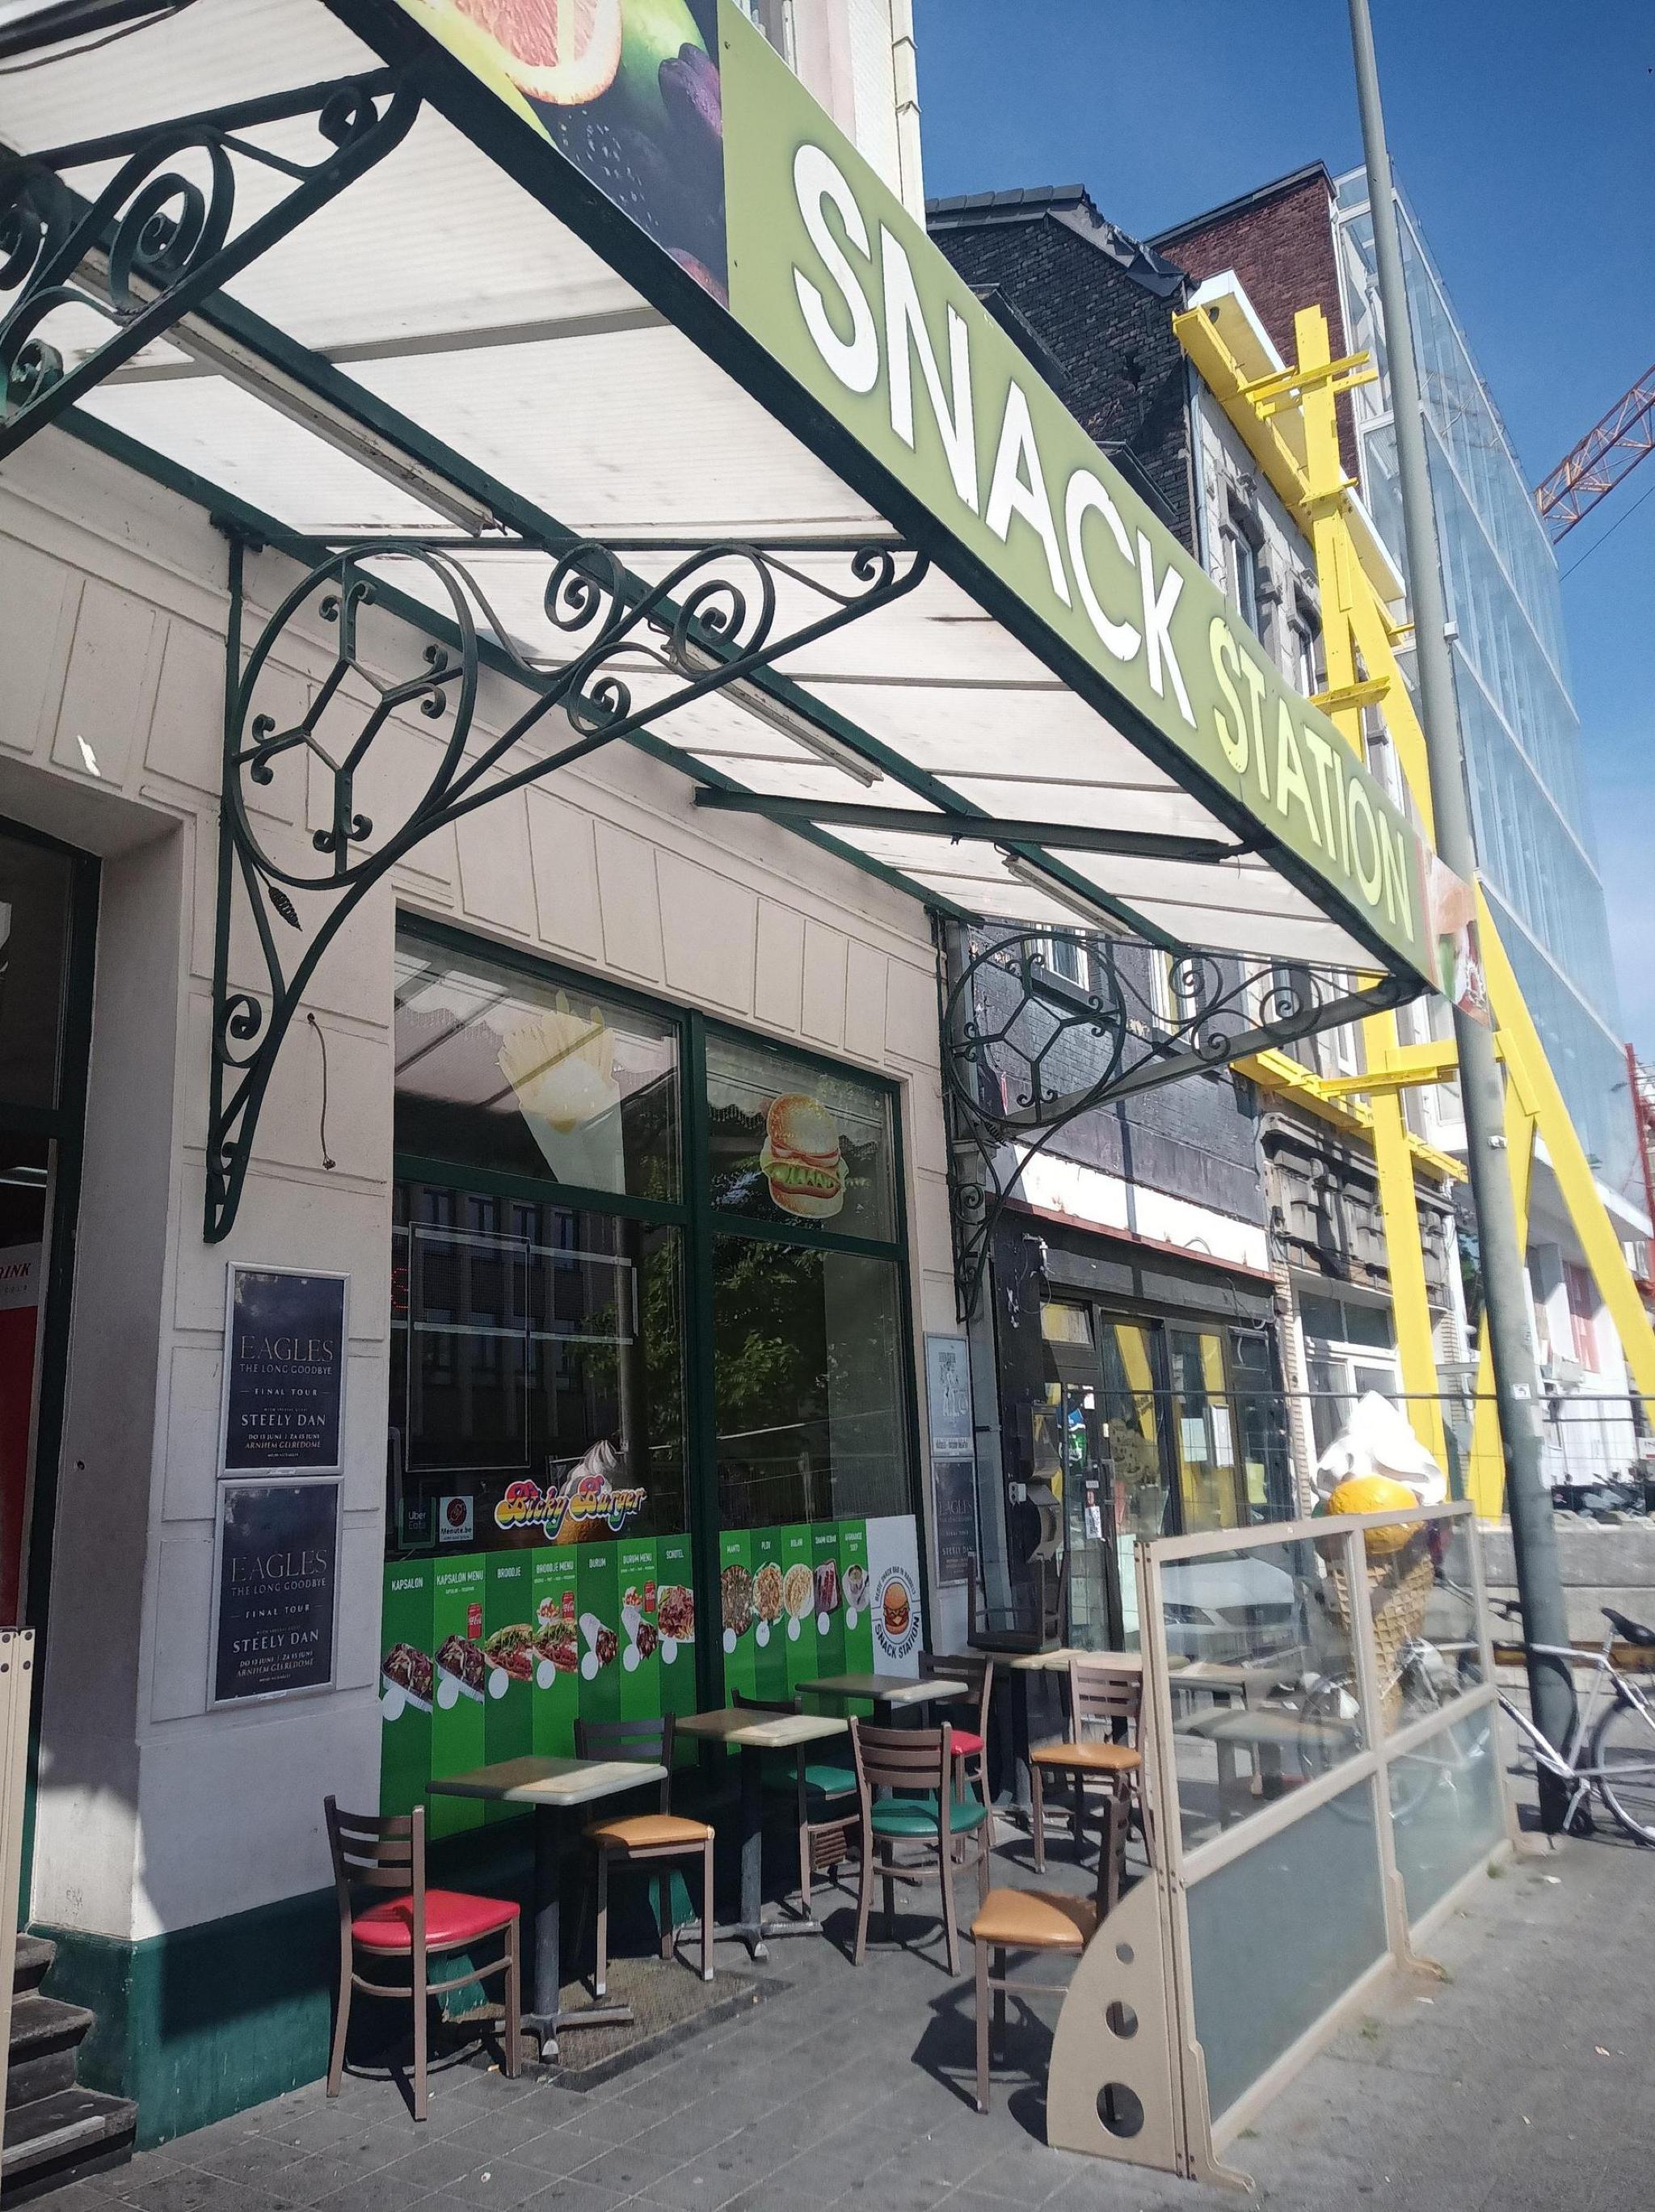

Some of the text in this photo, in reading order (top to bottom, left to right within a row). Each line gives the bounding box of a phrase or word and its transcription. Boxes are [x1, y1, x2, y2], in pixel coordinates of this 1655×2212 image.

[790, 144, 1414, 943] SNACK STATION
[241, 1335, 334, 1362] EAGLES
[240, 1363, 331, 1375] THE LONG GOODBYE
[255, 1388, 284, 1396] FINAL
[242, 1414, 325, 1426] STEELY DAN
[495, 1474, 648, 1540] Bicky Burger
[408, 1510, 426, 1520] Uber
[639, 1552, 653, 1563] MENU
[232, 1549, 326, 1582] EAGLES
[497, 1566, 521, 1578] BROODJE
[536, 1561, 575, 1574] BROODJE MENU
[391, 1577, 423, 1591] KAPSALON
[436, 1569, 484, 1586] KAPSALON MENU
[231, 1578, 326, 1597] THE LONG GOODBYE
[246, 1604, 310, 1619] FINAL TOUR
[233, 1634, 284, 1654] STEELY
[291, 1628, 318, 1645] DAN
[875, 1616, 920, 1659] SNACK STATION
